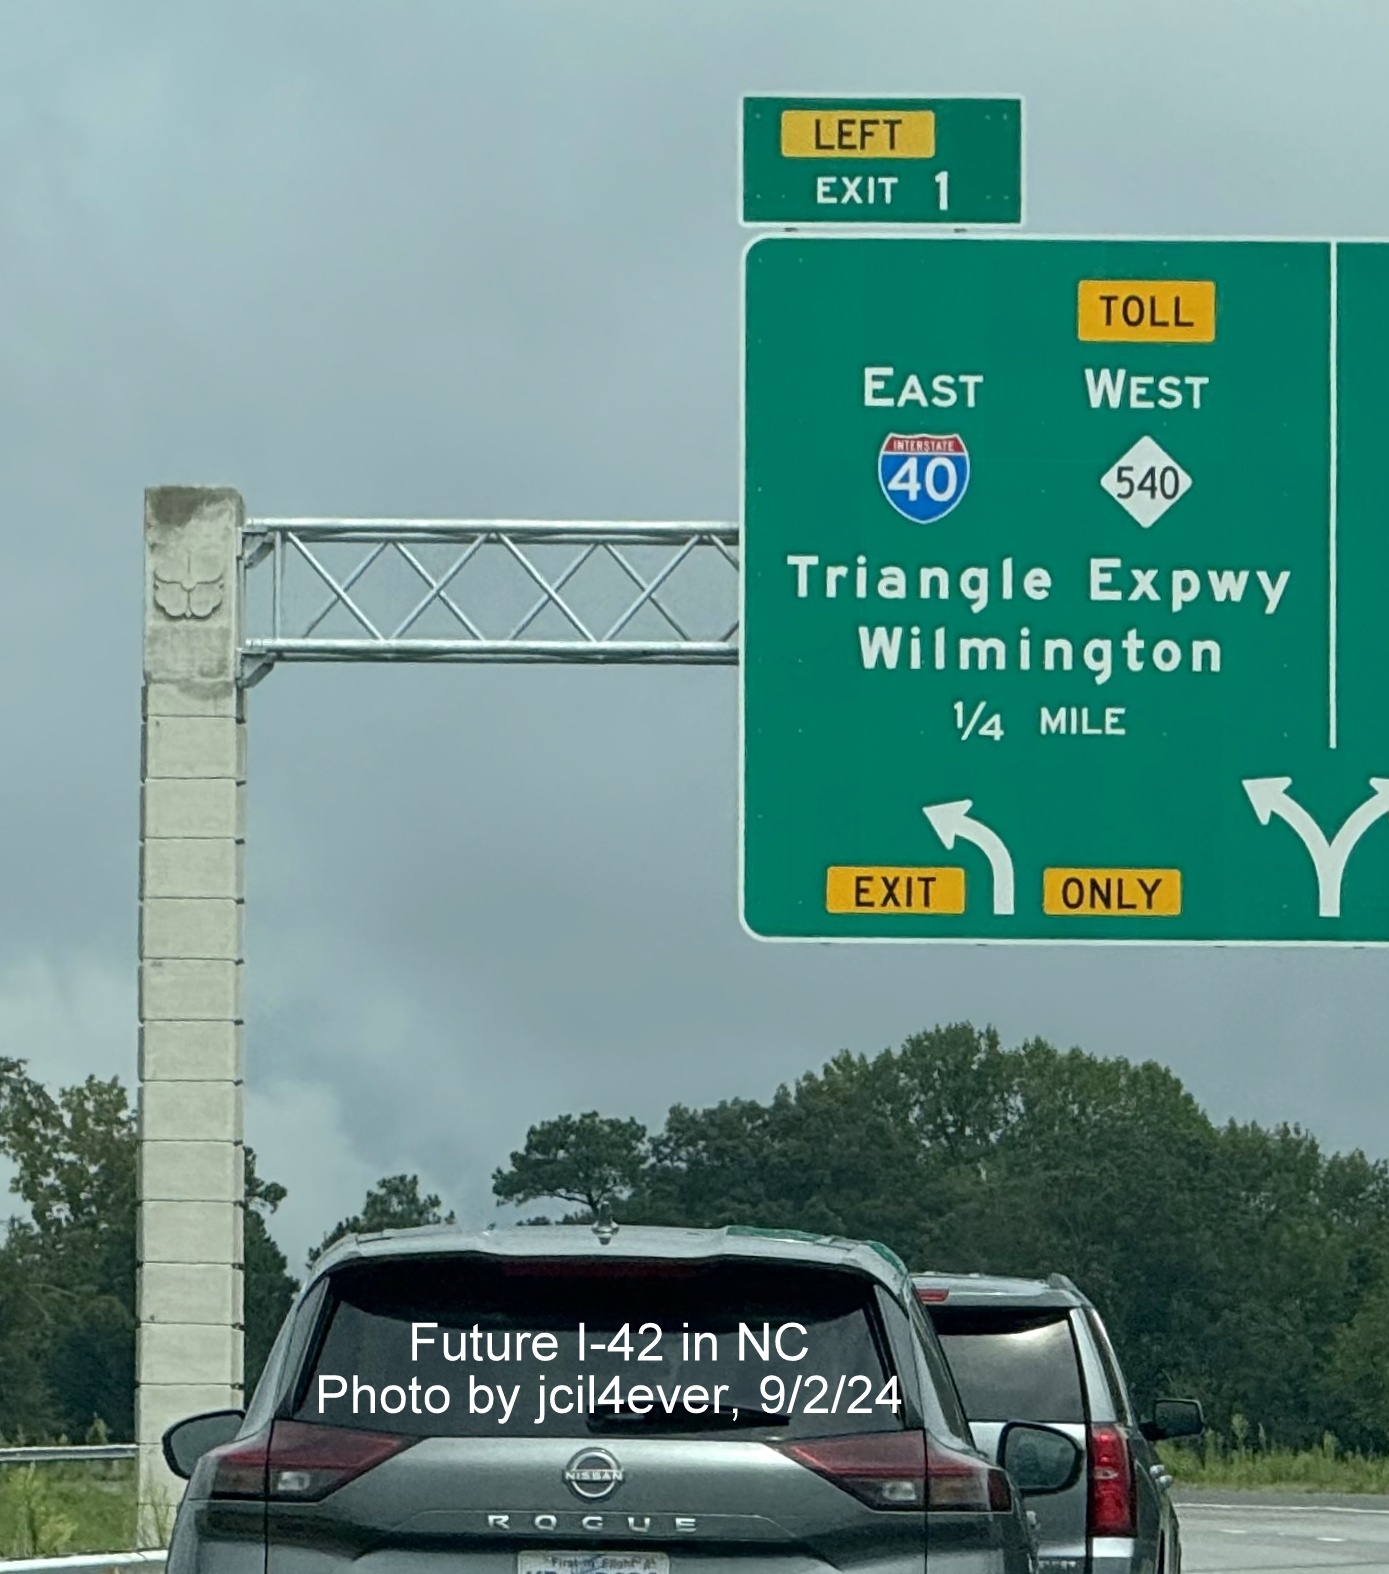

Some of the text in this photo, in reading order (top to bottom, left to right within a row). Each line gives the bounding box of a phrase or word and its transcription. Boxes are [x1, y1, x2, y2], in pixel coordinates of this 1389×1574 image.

[815, 119, 902, 150] LEFT
[816, 171, 948, 211] EXIT 1
[1099, 295, 1194, 327] TOLL
[864, 366, 984, 408] EAST
[1084, 368, 1210, 409] WEST
[893, 439, 955, 452] INTERSTATE
[887, 456, 958, 502] 40
[1115, 465, 1180, 501] 540
[786, 555, 1291, 614] Triangle Expwy
[858, 626, 1221, 685] Wilmington
[953, 701, 1126, 741] 1/4 MILE
[855, 876, 937, 908] EXIT
[1061, 877, 1162, 910] ONLY
[565, 1470, 623, 1481] NISSAN
[488, 1514, 698, 1533] ROGUE
